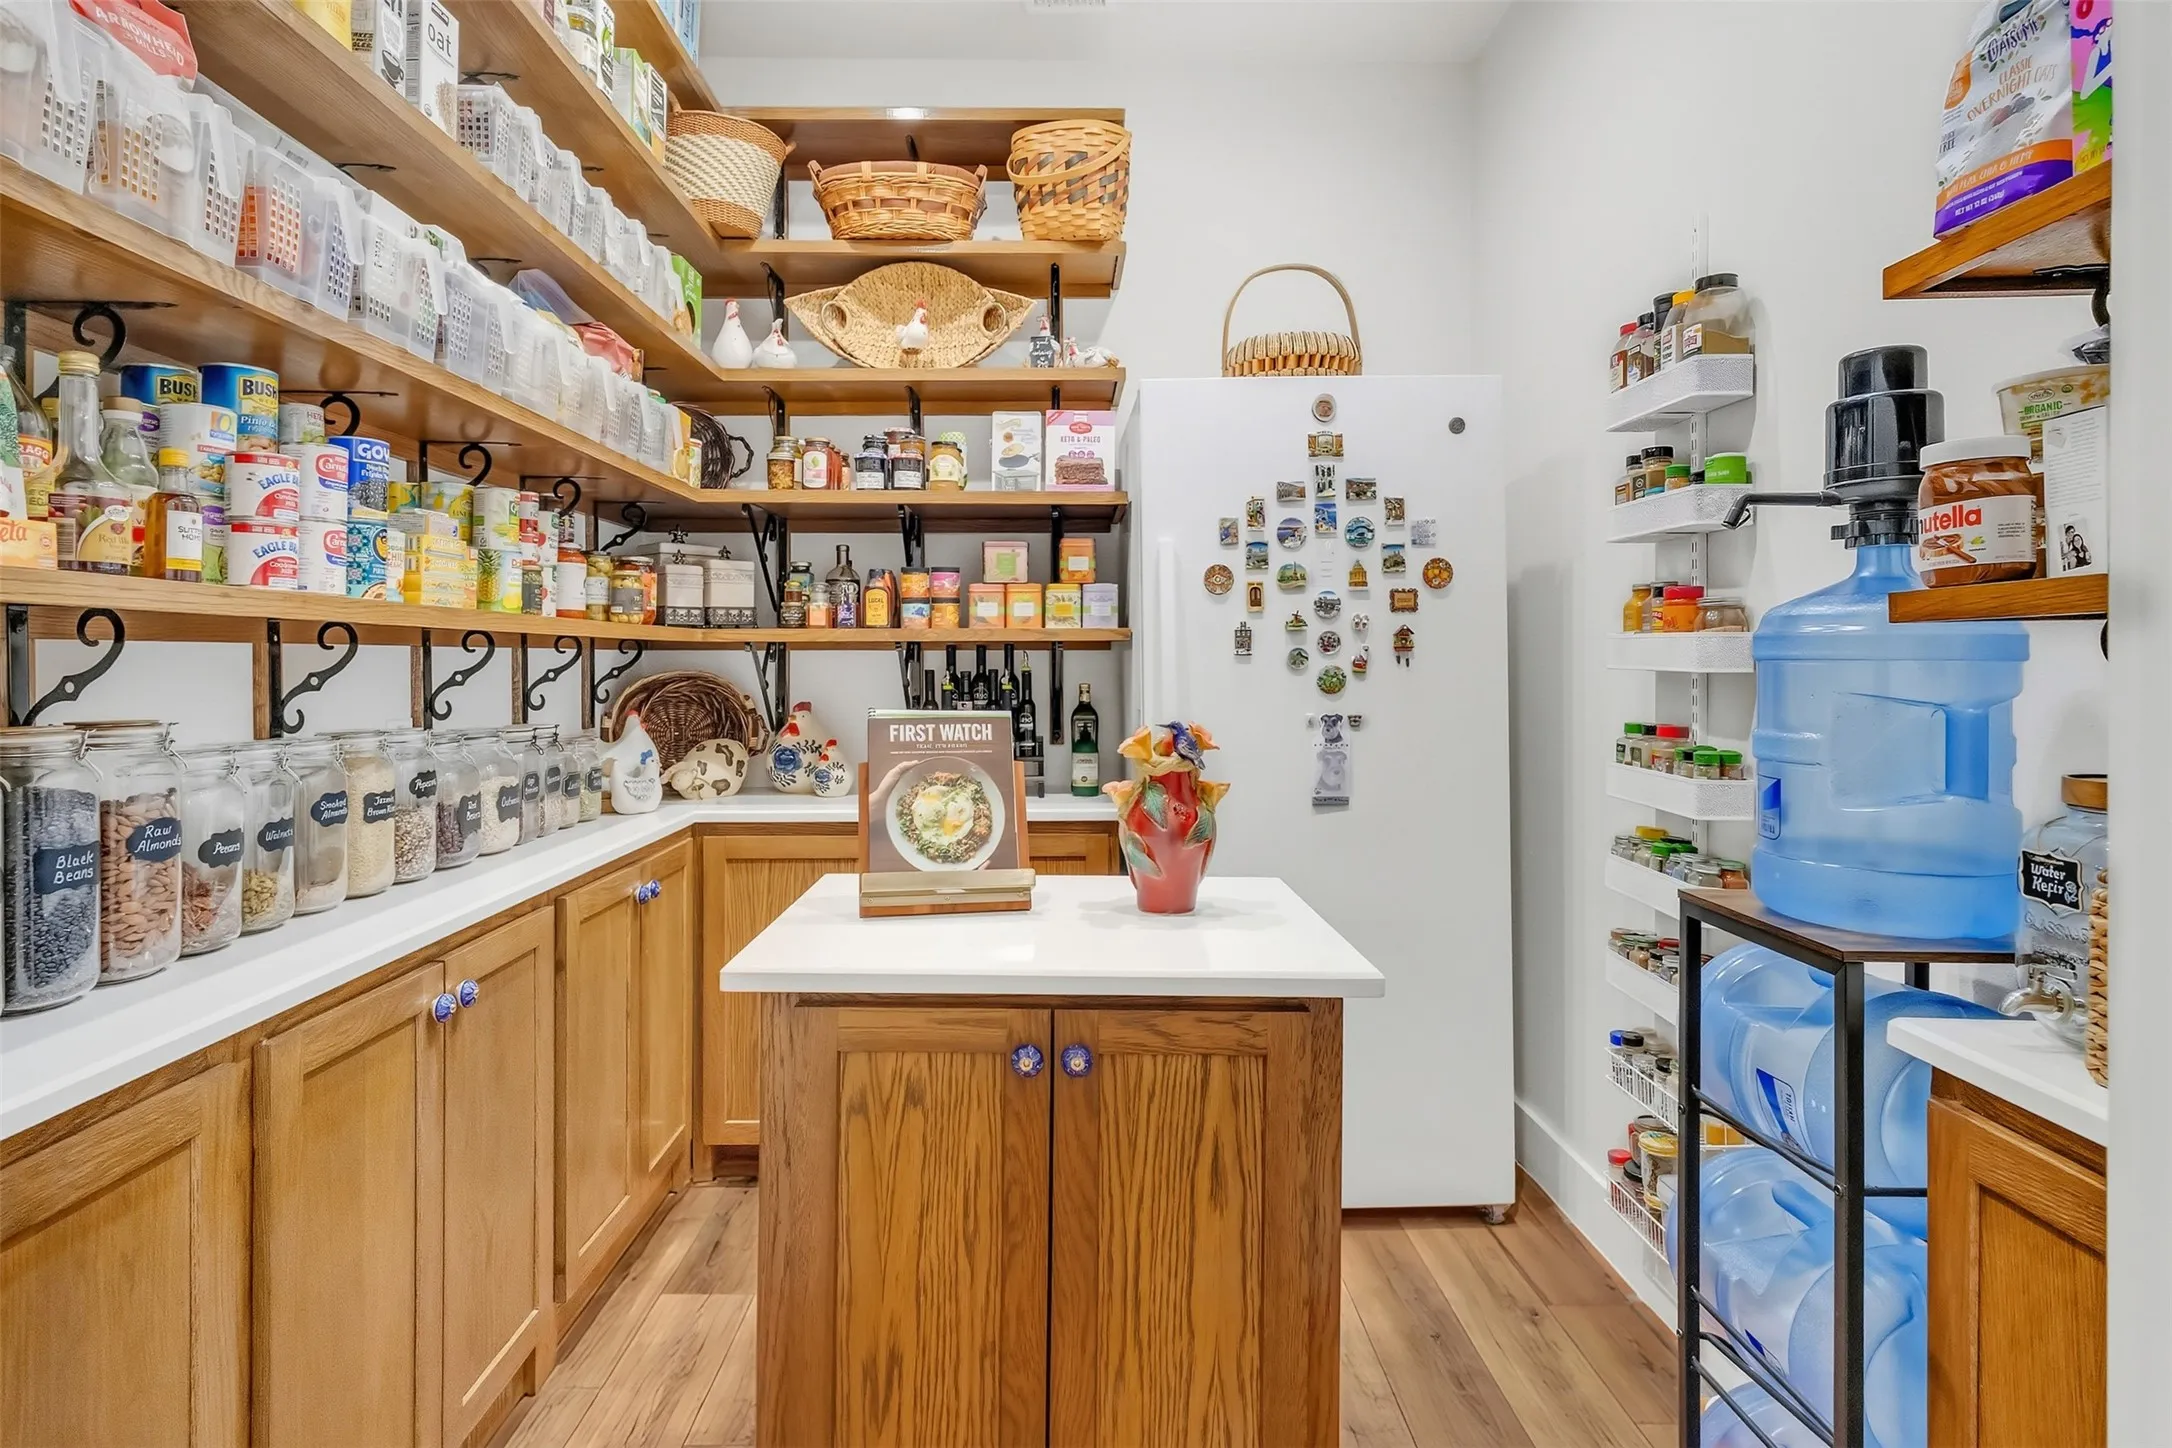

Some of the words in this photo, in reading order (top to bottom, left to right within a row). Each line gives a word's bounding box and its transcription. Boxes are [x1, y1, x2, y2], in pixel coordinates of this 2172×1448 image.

[427, 23, 453, 58] oat
[2000, 55, 2033, 85] CLASSIC
[1966, 69, 2033, 122] OVERNIGHT
[2023, 400, 2064, 415] ORGANIC
[240, 415, 267, 427] Pinto
[258, 472, 290, 490] EAGLE
[253, 540, 287, 558] EAGLE
[889, 724, 936, 743] FIRST
[939, 723, 993, 742] WATCH
[319, 797, 347, 811] Smoked
[145, 824, 173, 838] Raw
[265, 828, 294, 842] Walnuts
[134, 834, 182, 853] Almonds
[212, 842, 241, 855] Pecans
[55, 851, 94, 869] Black
[53, 867, 94, 885] Beans
[2030, 862, 2067, 881] Water
[2031, 875, 2065, 898] Kefir
